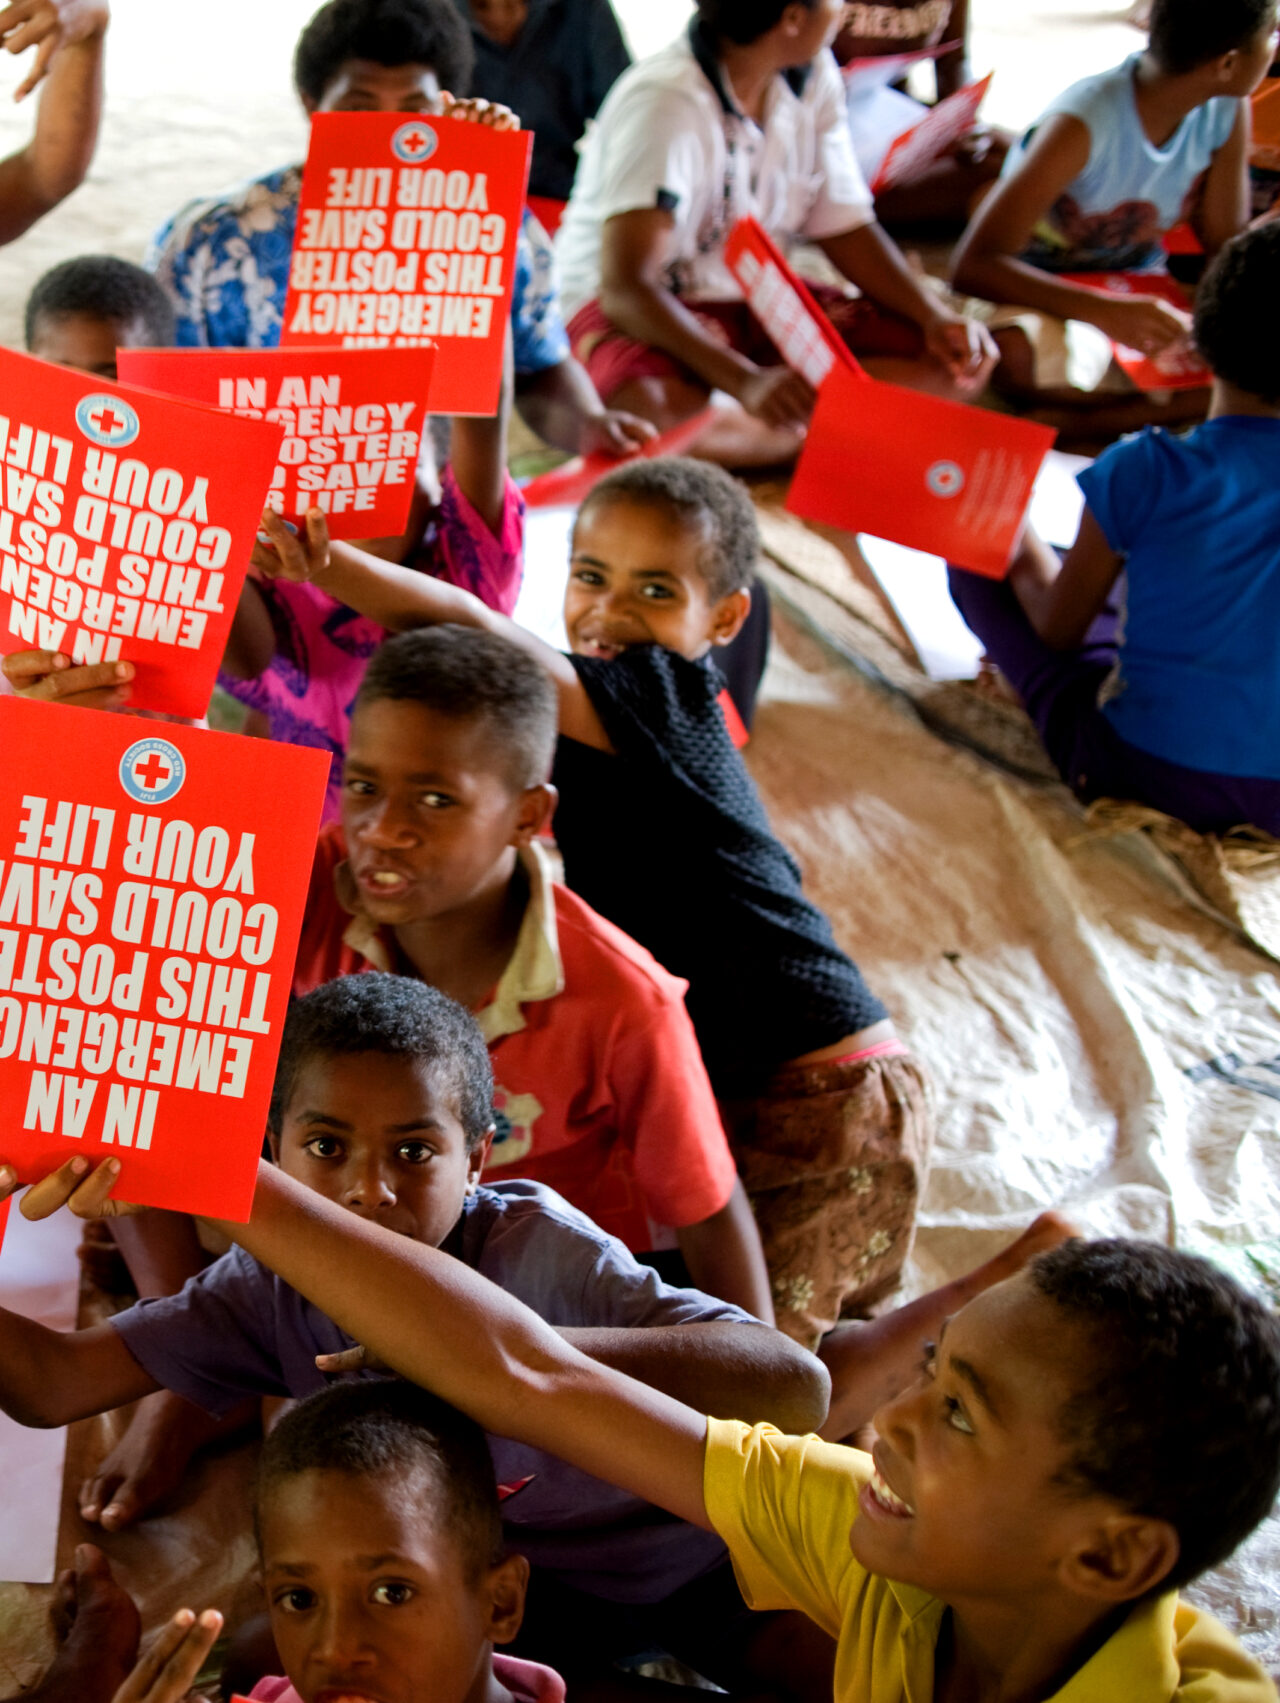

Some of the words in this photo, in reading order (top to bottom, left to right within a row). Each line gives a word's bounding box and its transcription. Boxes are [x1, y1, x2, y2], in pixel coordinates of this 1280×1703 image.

[326, 168, 392, 207] LIFE
[397, 169, 489, 212] YOUR
[300, 209, 386, 249] SAVE
[390, 210, 506, 254] COULD
[289, 250, 418, 291] POSTER
[423, 253, 504, 296] THIS
[289, 293, 493, 338] EMERGENCY
[219, 377, 267, 408] IN
[276, 374, 341, 407] AN
[278, 431, 419, 465] OSTER
[82, 446, 208, 524] YOUR
[297, 458, 408, 490] SAVE
[296, 487, 377, 516] LIFE
[73, 494, 231, 570] COULD
[116, 554, 224, 613] THIS
[9, 599, 67, 652] AN
[73, 628, 122, 665] IN
[152, 742, 177, 759] CROSS
[14, 795, 116, 869] LIFE
[122, 813, 255, 895] YOUR
[111, 881, 278, 965] COULD
[156, 956, 271, 1035] THIS
[23, 1070, 98, 1139] AN
[101, 1083, 160, 1150] IN
